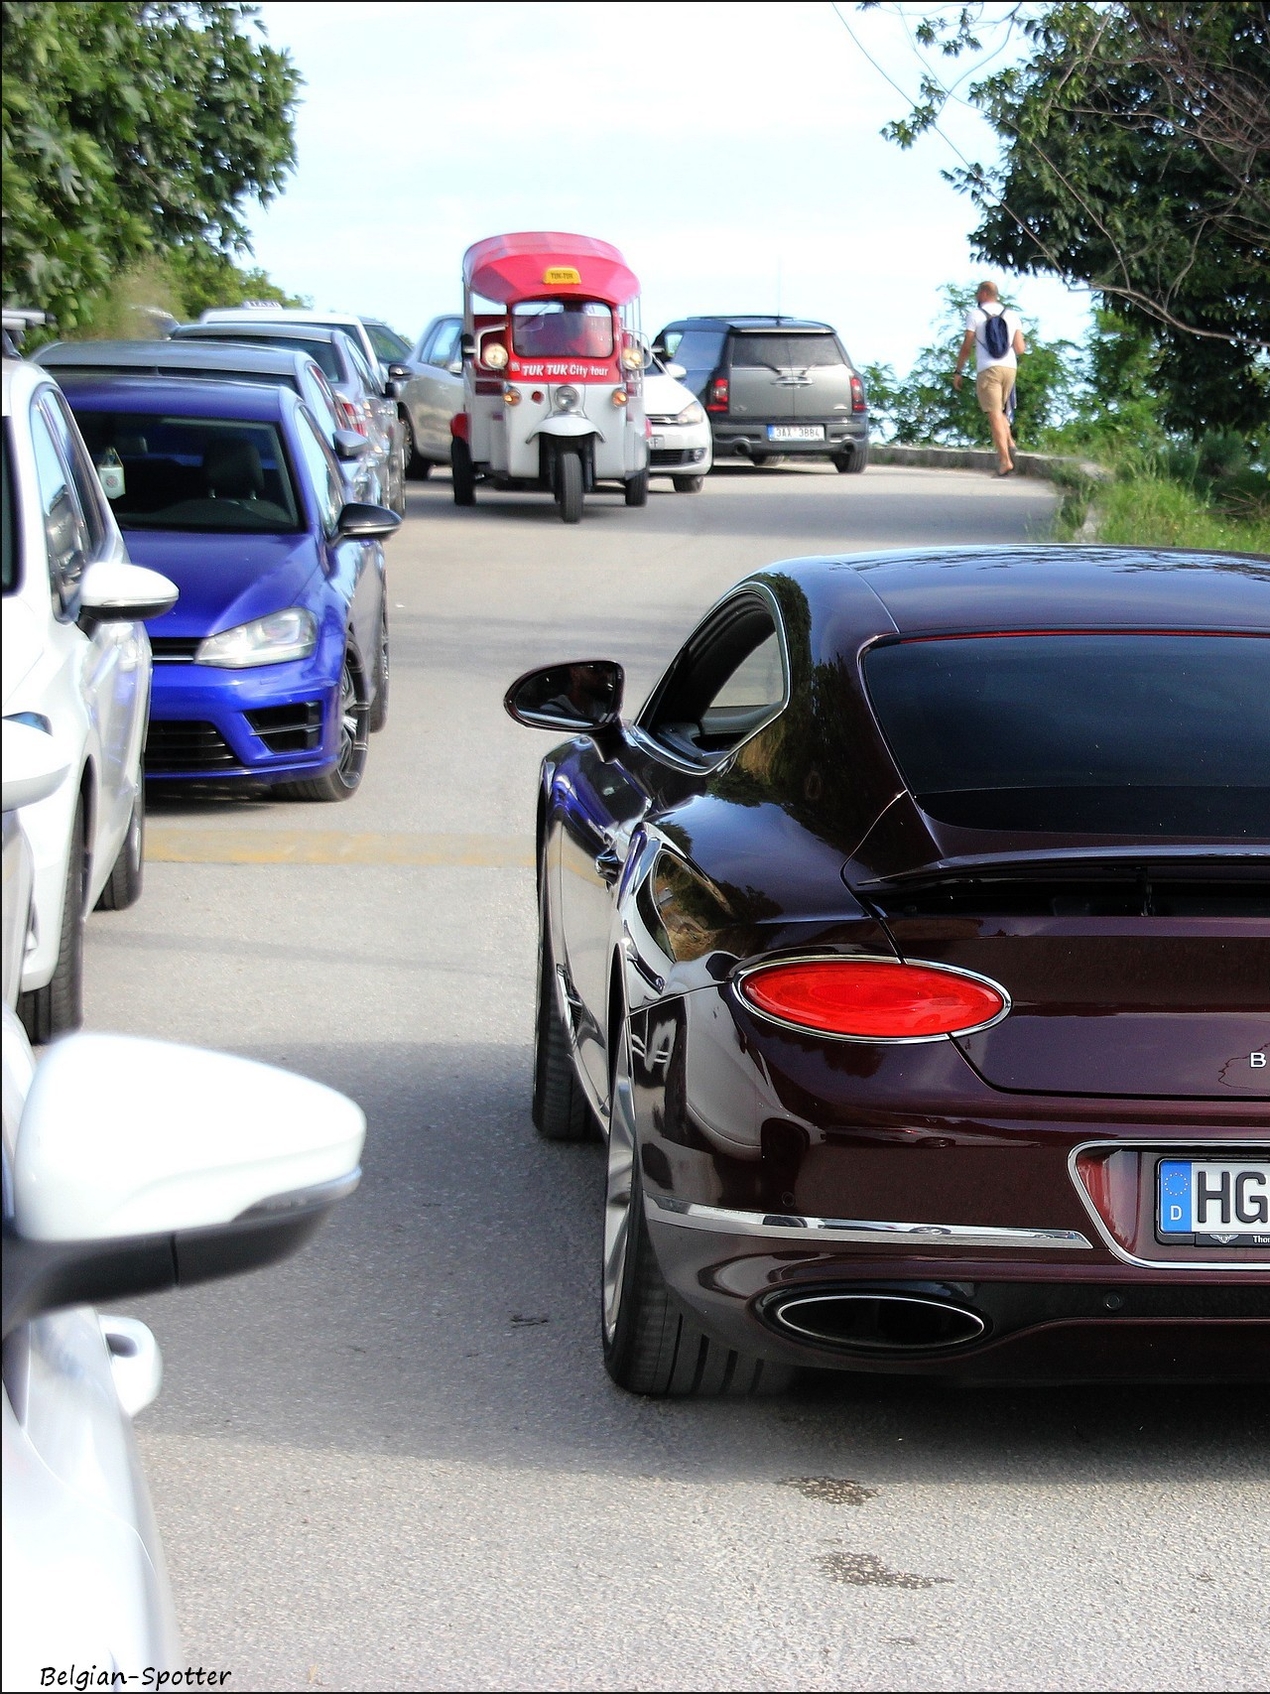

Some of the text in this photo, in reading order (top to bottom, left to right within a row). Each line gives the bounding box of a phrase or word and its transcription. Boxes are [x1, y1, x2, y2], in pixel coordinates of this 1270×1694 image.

[522, 363, 608, 378] TUK TUK City tour
[1197, 1171, 1268, 1223] HG
[1169, 1205, 1182, 1221] D
